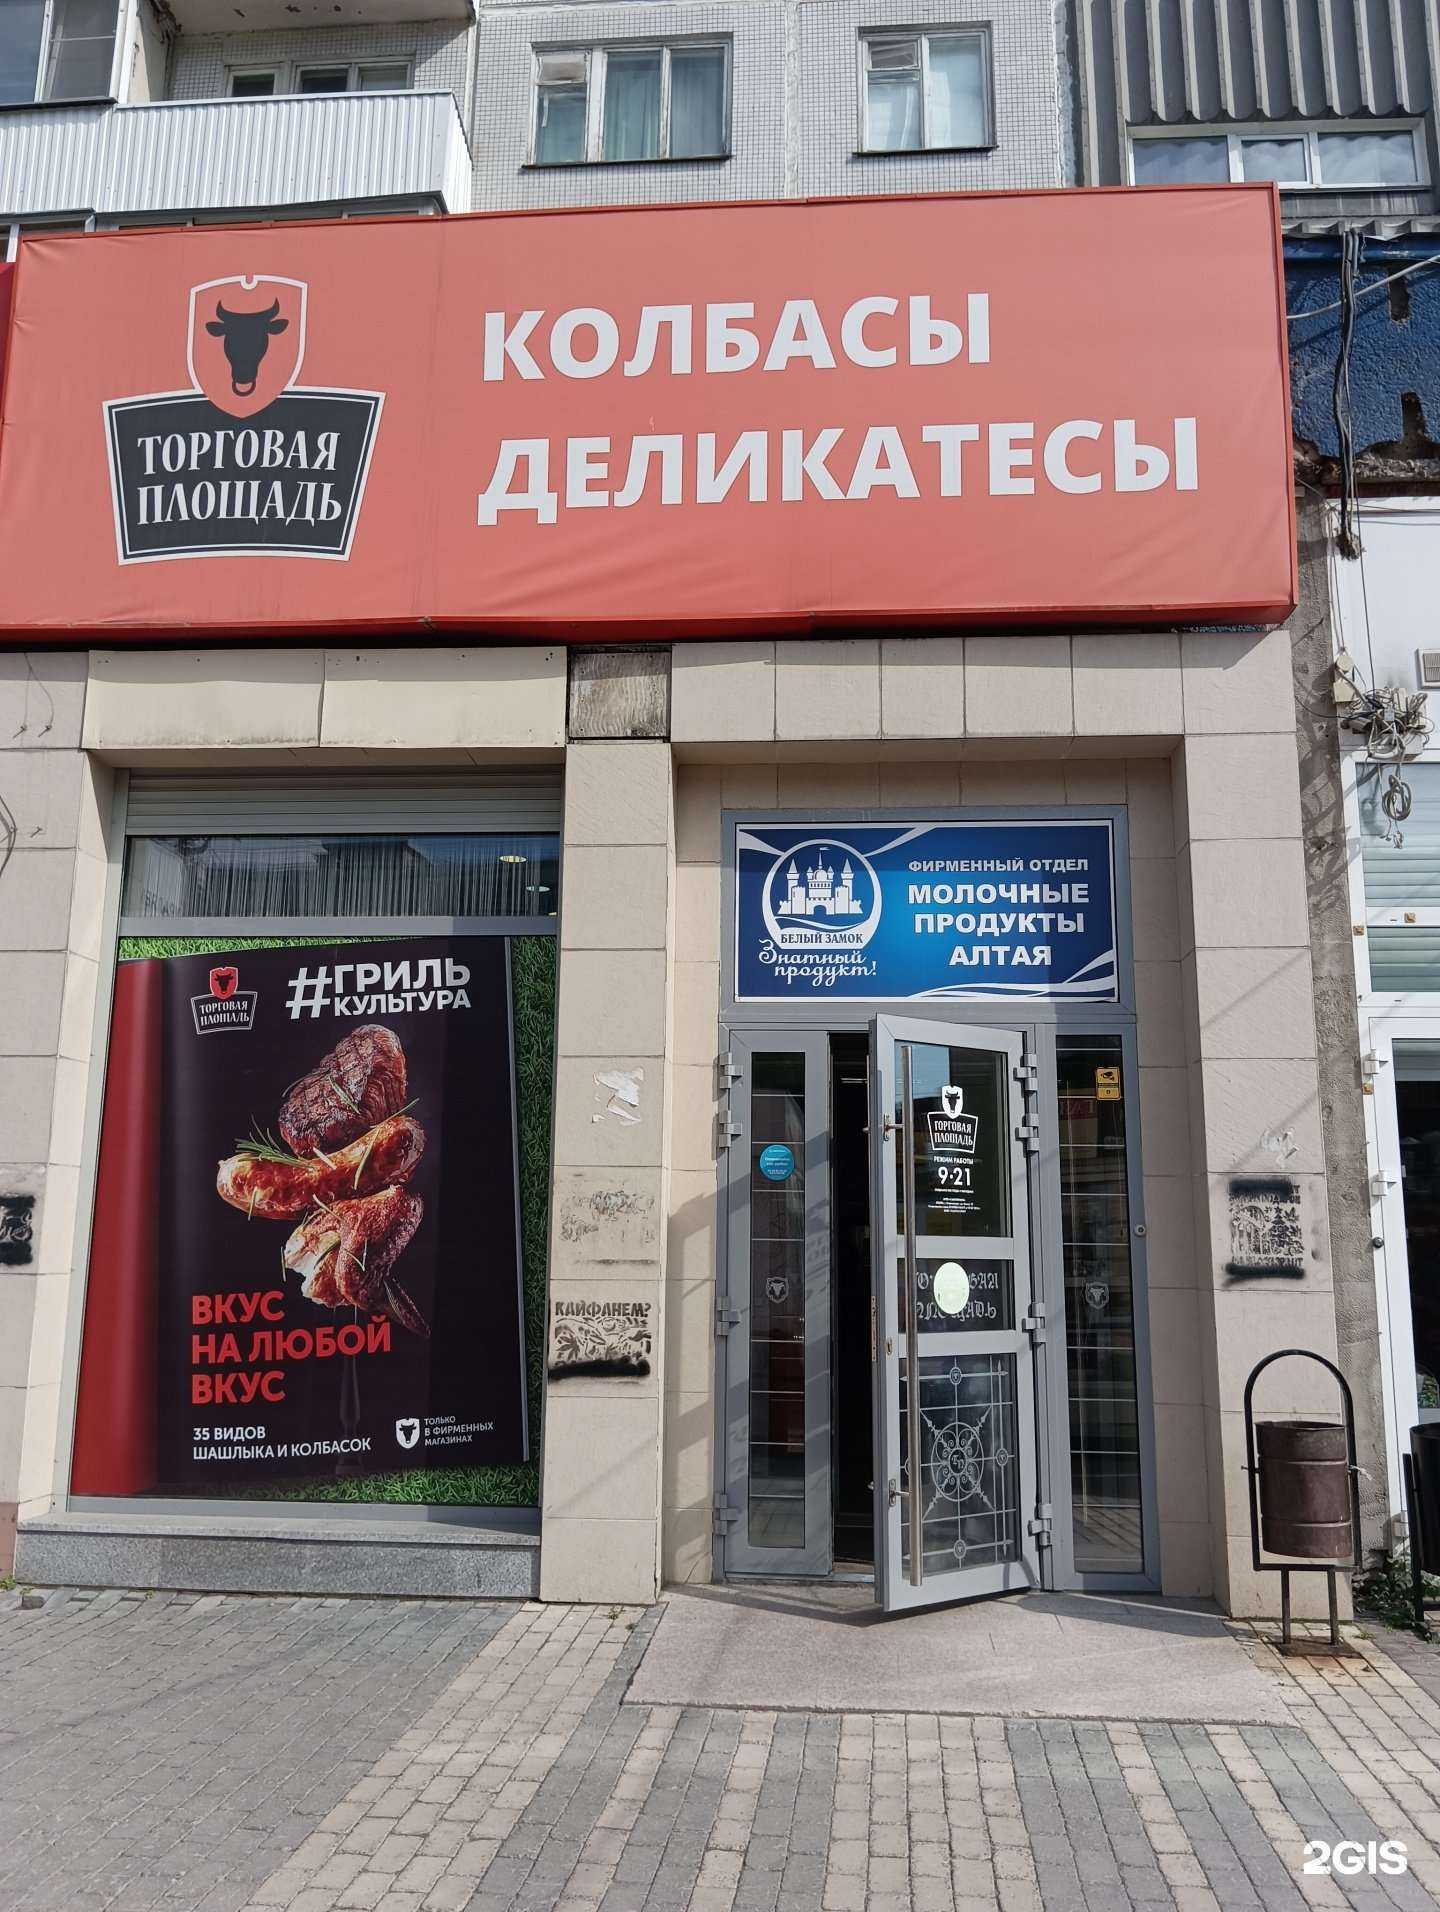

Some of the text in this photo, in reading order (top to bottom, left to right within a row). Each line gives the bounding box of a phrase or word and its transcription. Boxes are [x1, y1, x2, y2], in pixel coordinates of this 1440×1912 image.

[483, 293, 991, 381] КОЛБАСЫ
[137, 429, 341, 475] ТОРГОВАЯ
[477, 417, 1199, 526] ДЕЛИКАТЕСЫ
[137, 480, 342, 527] ПЛОЩАДЬ
[908, 857, 1089, 873] ФИРМЕННЫЙ ОТДЕЛ
[908, 883, 1090, 905] МОЛОЧНЫЕ
[914, 912, 1085, 936] ПРОДУКТЫ
[781, 931, 864, 944] БЕЛЫЙ ЗАМОК
[758, 939, 867, 964] Знатный
[948, 945, 1052, 966] АЛТАЯ
[774, 960, 877, 987] продукт!
[199, 1000, 249, 1015] ТОРГОВАЯ
[334, 988, 472, 1018] КУЛЬТУРА
[934, 1120, 972, 1134] ТОРГОВАЯ
[192, 1290, 285, 1325] ВКУС
[192, 1314, 391, 1364] НА ЛЮБОЙ
[192, 1370, 286, 1405] ВКУС
[424, 1415, 456, 1426] ТОЛЬКО
[425, 1421, 494, 1436] В ФИРМЕННЫХ
[193, 1425, 266, 1442] 35 ВИДОВ
[425, 1434, 473, 1446] МАГАЗИНАХ
[193, 1437, 371, 1460] ШАШЛЫКА И КОЛБАСОК
